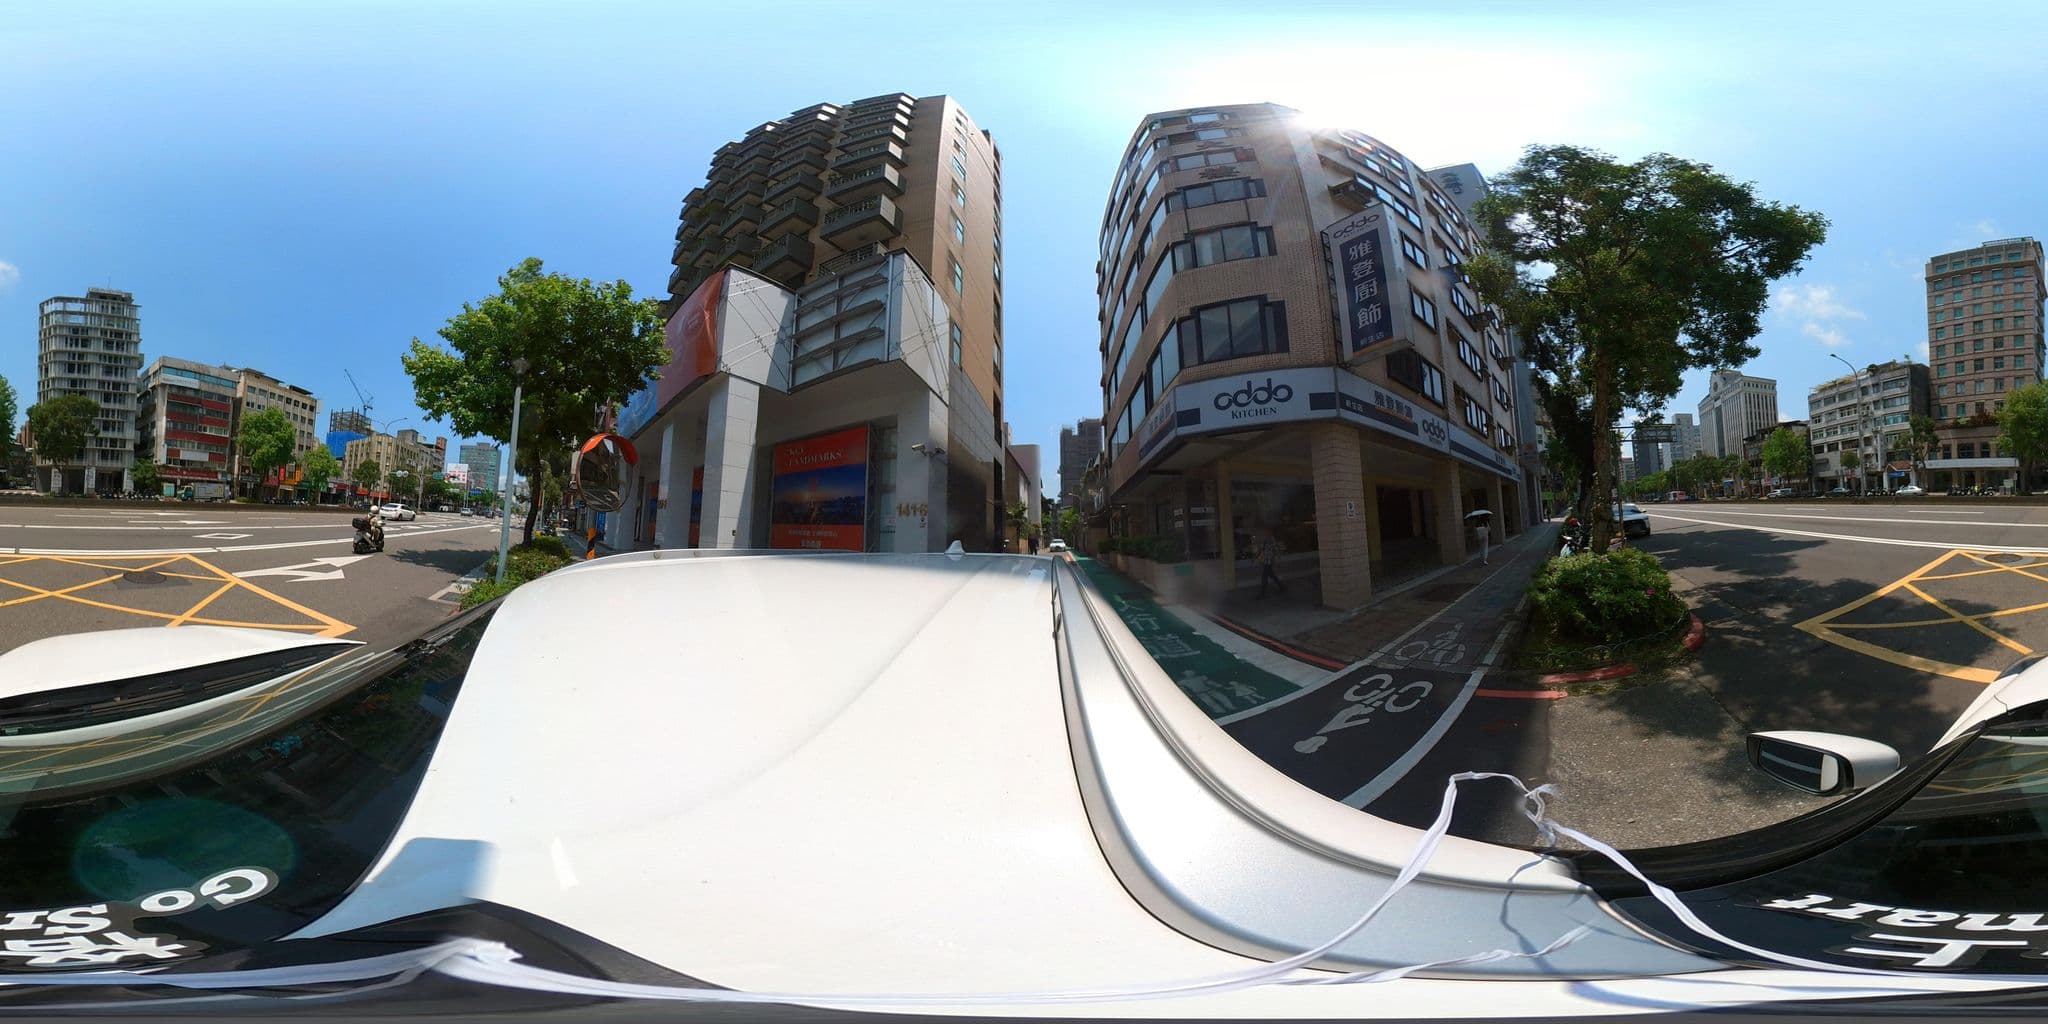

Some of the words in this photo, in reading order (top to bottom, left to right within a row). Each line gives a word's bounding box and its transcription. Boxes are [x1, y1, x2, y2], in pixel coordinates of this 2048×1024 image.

[1348, 239, 1382, 329] 雅登廚飾
[1213, 377, 1293, 411] oddo
[1231, 406, 1278, 420] KITCHEN
[139, 868, 269, 912] Go
